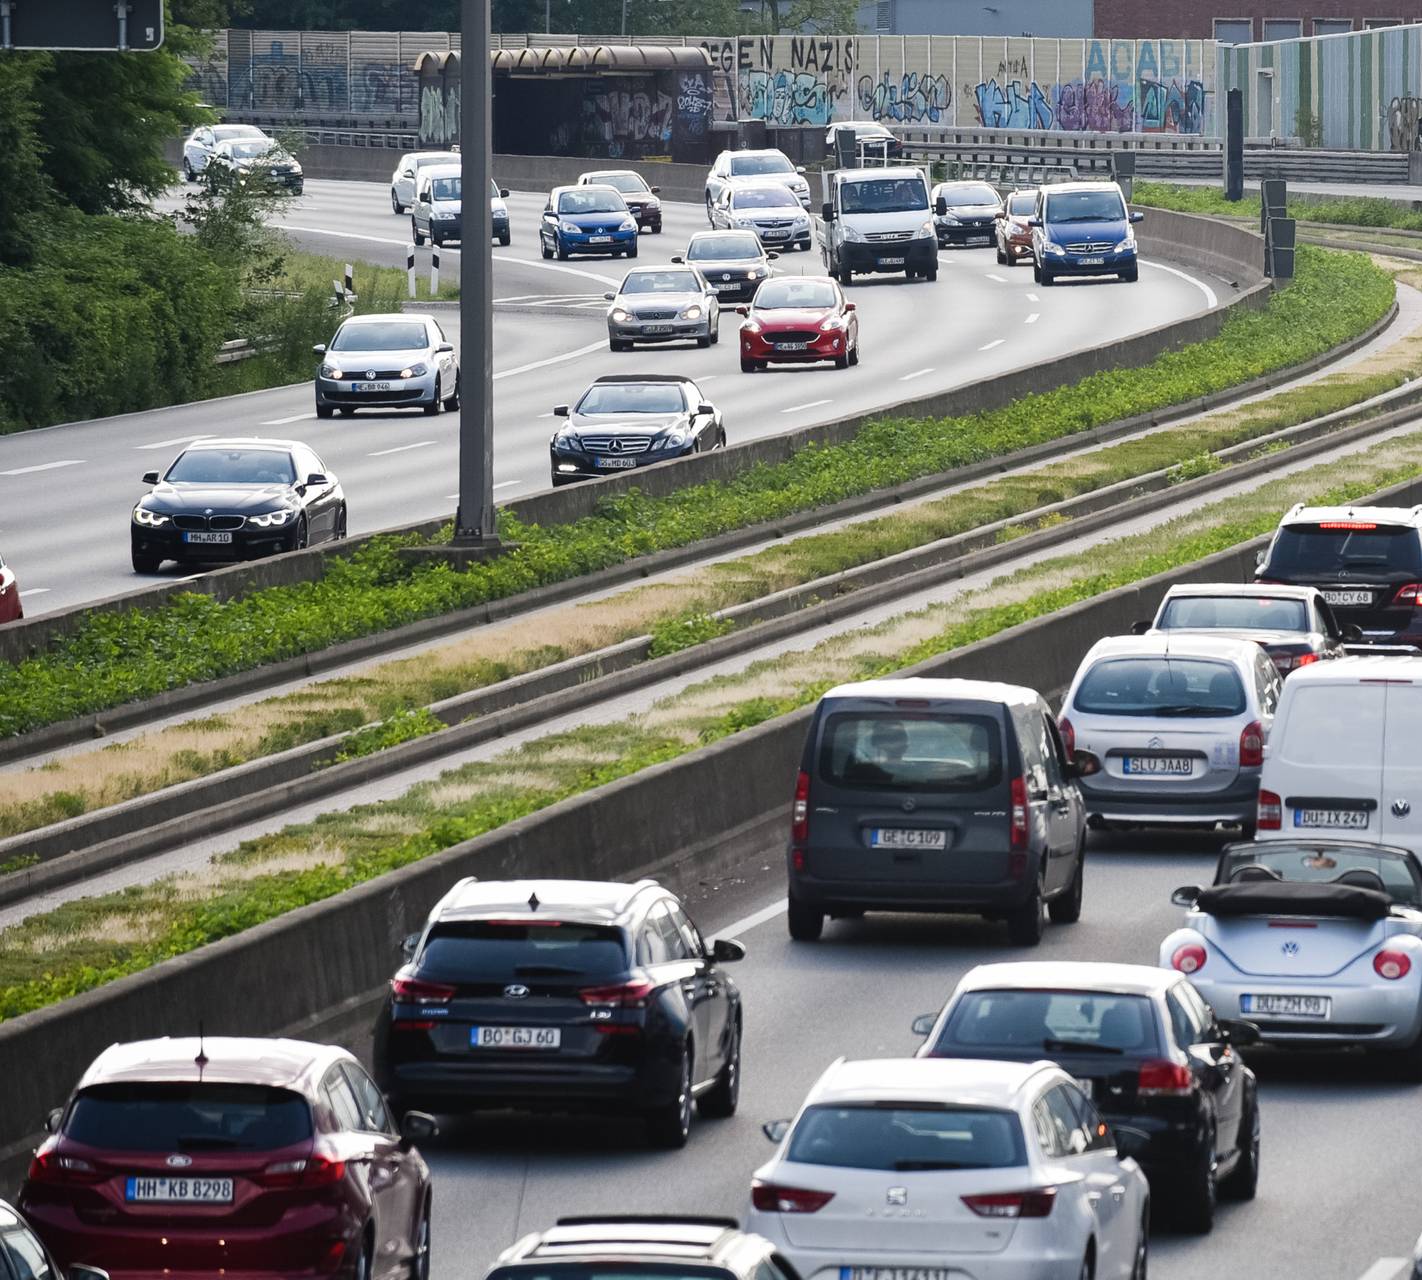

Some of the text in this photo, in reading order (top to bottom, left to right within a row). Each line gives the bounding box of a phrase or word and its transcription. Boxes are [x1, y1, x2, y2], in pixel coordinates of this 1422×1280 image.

[791, 37, 860, 72] NAZIS!
[1342, 592, 1355, 602] CY
[1357, 592, 1368, 602] 68
[1132, 758, 1157, 770] SLU
[1303, 811, 1366, 825] DU IX 247
[883, 831, 940, 844] GE C 109
[483, 1028, 554, 1044] BO GJ 60
[137, 1179, 231, 1199] HH KB 8298
